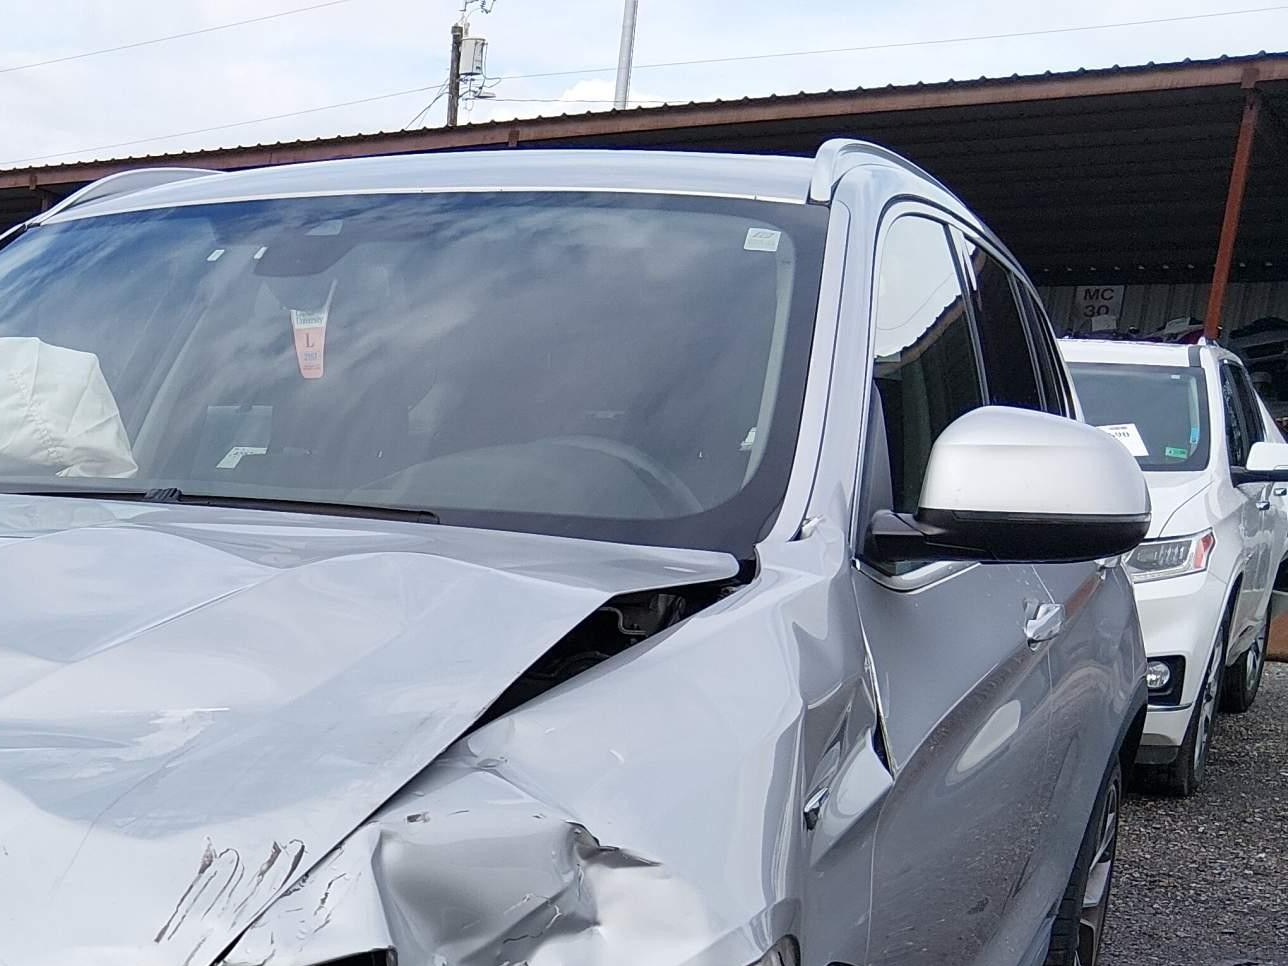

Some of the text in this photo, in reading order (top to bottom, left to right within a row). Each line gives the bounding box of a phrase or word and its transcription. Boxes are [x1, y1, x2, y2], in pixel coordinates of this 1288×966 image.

[1084, 288, 1114, 301] MC
[1083, 304, 1109, 317] 30
[304, 333, 315, 348] L
